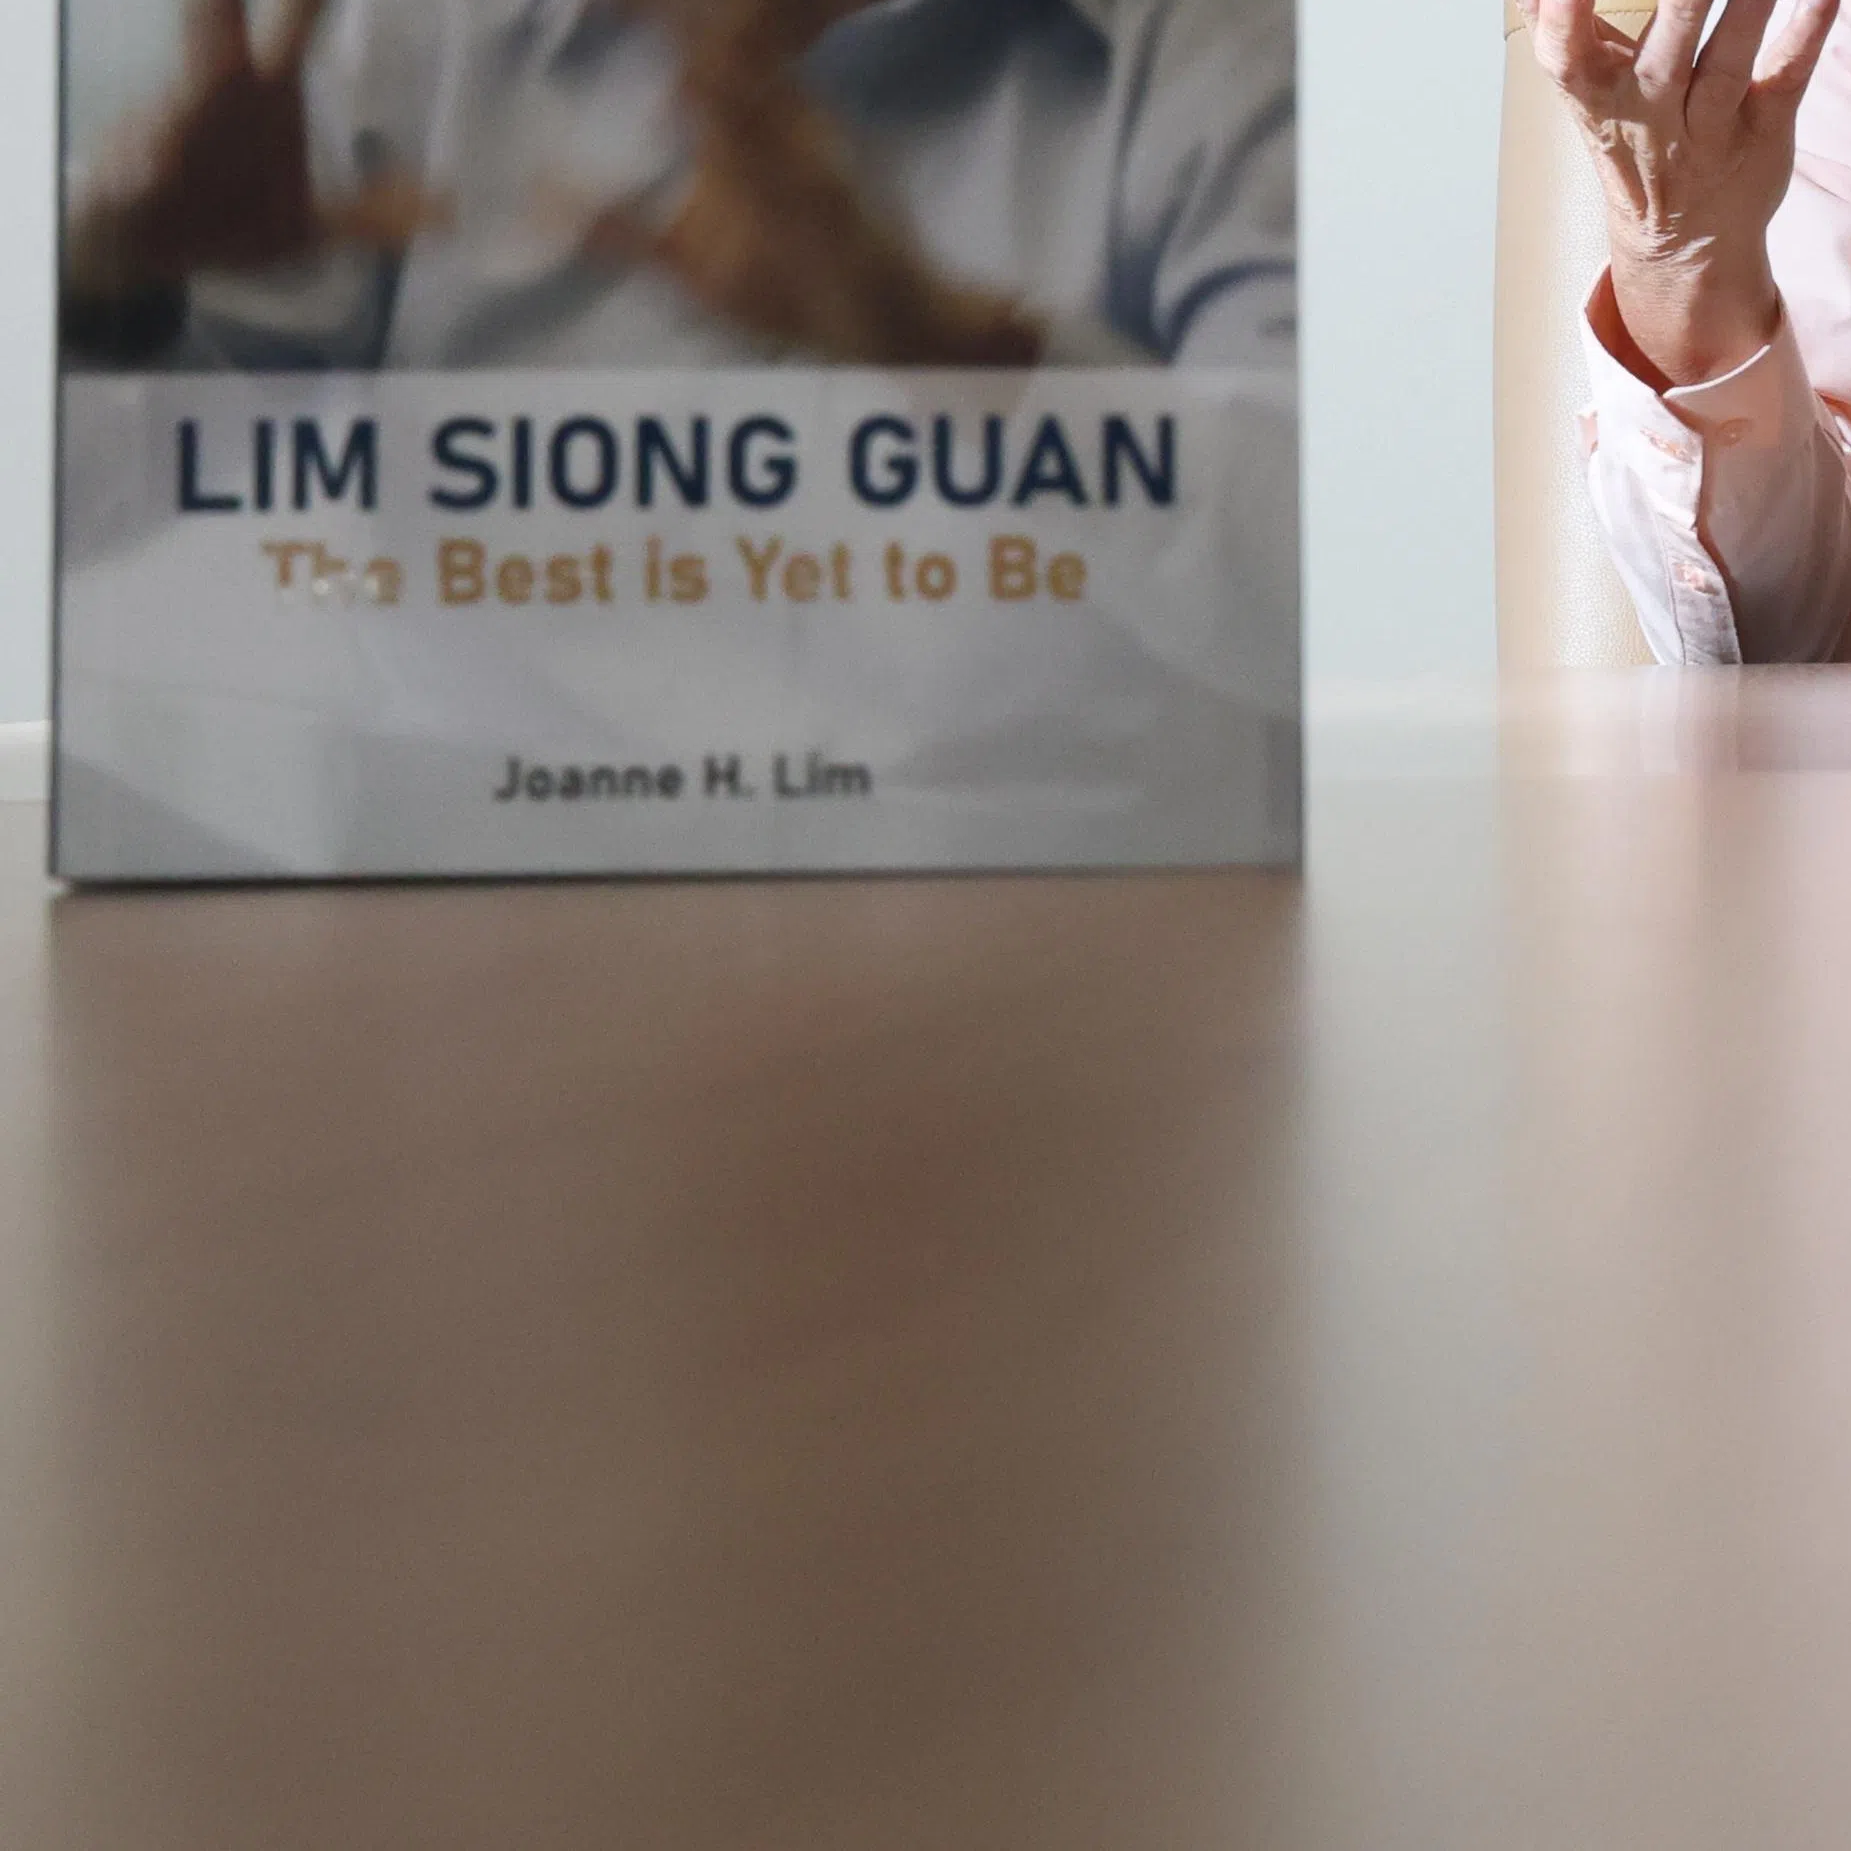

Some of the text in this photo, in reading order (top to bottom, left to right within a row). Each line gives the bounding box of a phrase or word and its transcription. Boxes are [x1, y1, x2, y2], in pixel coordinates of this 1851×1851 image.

[177, 413, 1177, 513] LIM SIONG GUAN
[440, 540, 614, 605] Best
[645, 534, 708, 603] is
[735, 538, 850, 603] Yet
[885, 542, 954, 601] to
[988, 537, 1086, 601] Be
[494, 754, 871, 803] Joanne H. Lim
